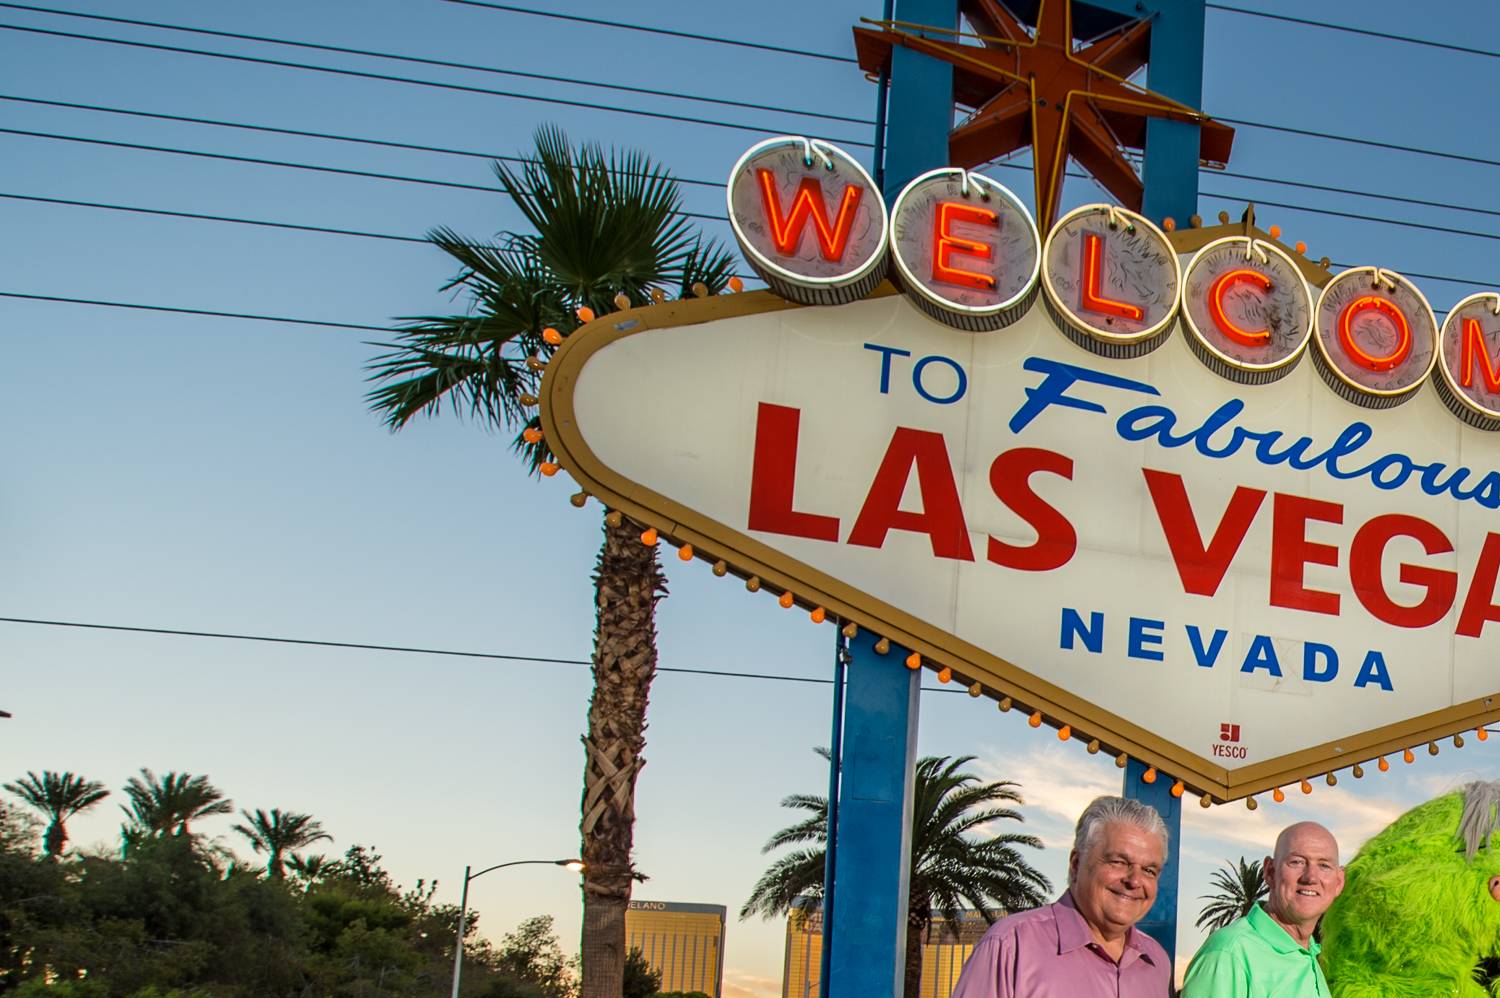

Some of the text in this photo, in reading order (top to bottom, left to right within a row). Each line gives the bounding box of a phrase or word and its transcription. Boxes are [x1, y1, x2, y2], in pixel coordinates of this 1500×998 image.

[863, 343, 968, 405] TO
[747, 401, 1078, 572] LAS
[1059, 607, 1395, 692] NEVADA
[1212, 744, 1247, 760] YESCO
